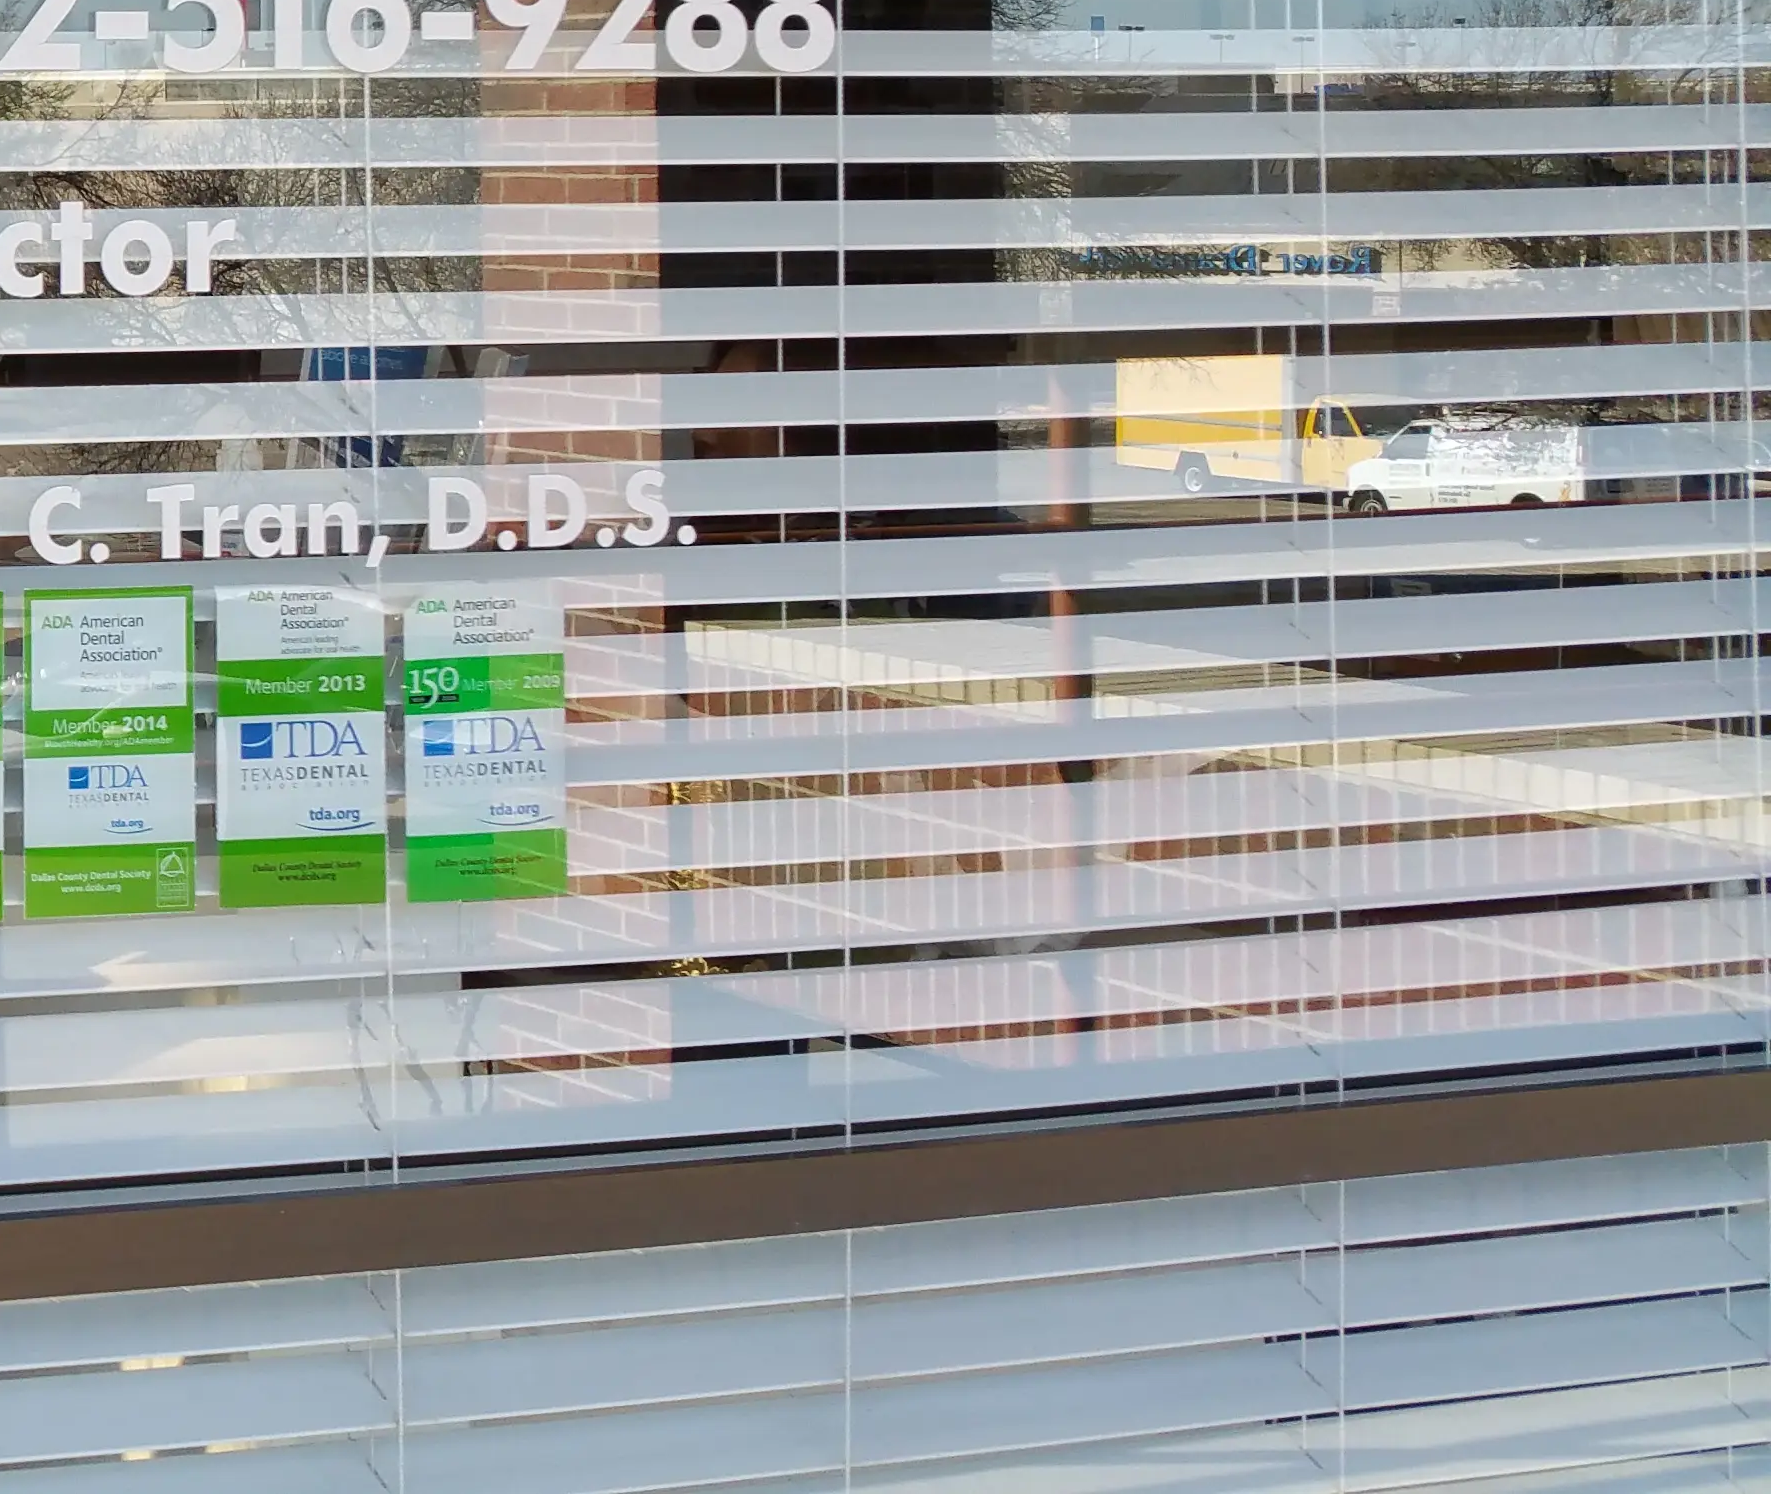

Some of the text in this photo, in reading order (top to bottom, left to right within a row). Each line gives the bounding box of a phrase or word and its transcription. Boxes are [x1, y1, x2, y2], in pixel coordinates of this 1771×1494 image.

[28, 486, 110, 566] C.
[146, 482, 391, 569] Tran,
[427, 469, 699, 555] D.D.S.
[247, 590, 333, 602] ADA American
[280, 603, 317, 616] Dental
[416, 597, 516, 614] ADA American
[41, 614, 144, 629] ADA American
[453, 613, 497, 628] Dental
[80, 631, 125, 646] Dental
[246, 674, 366, 694] Member 2013
[409, 666, 459, 710] 150
[522, 674, 561, 689] 2009
[53, 715, 168, 734] Member 2014
[275, 719, 369, 758] TDA
[456, 716, 546, 755] TDA
[90, 764, 149, 789] TDA
[308, 807, 361, 822] tda.org
[489, 802, 540, 817] tda.org
[110, 819, 144, 829] tda.org
